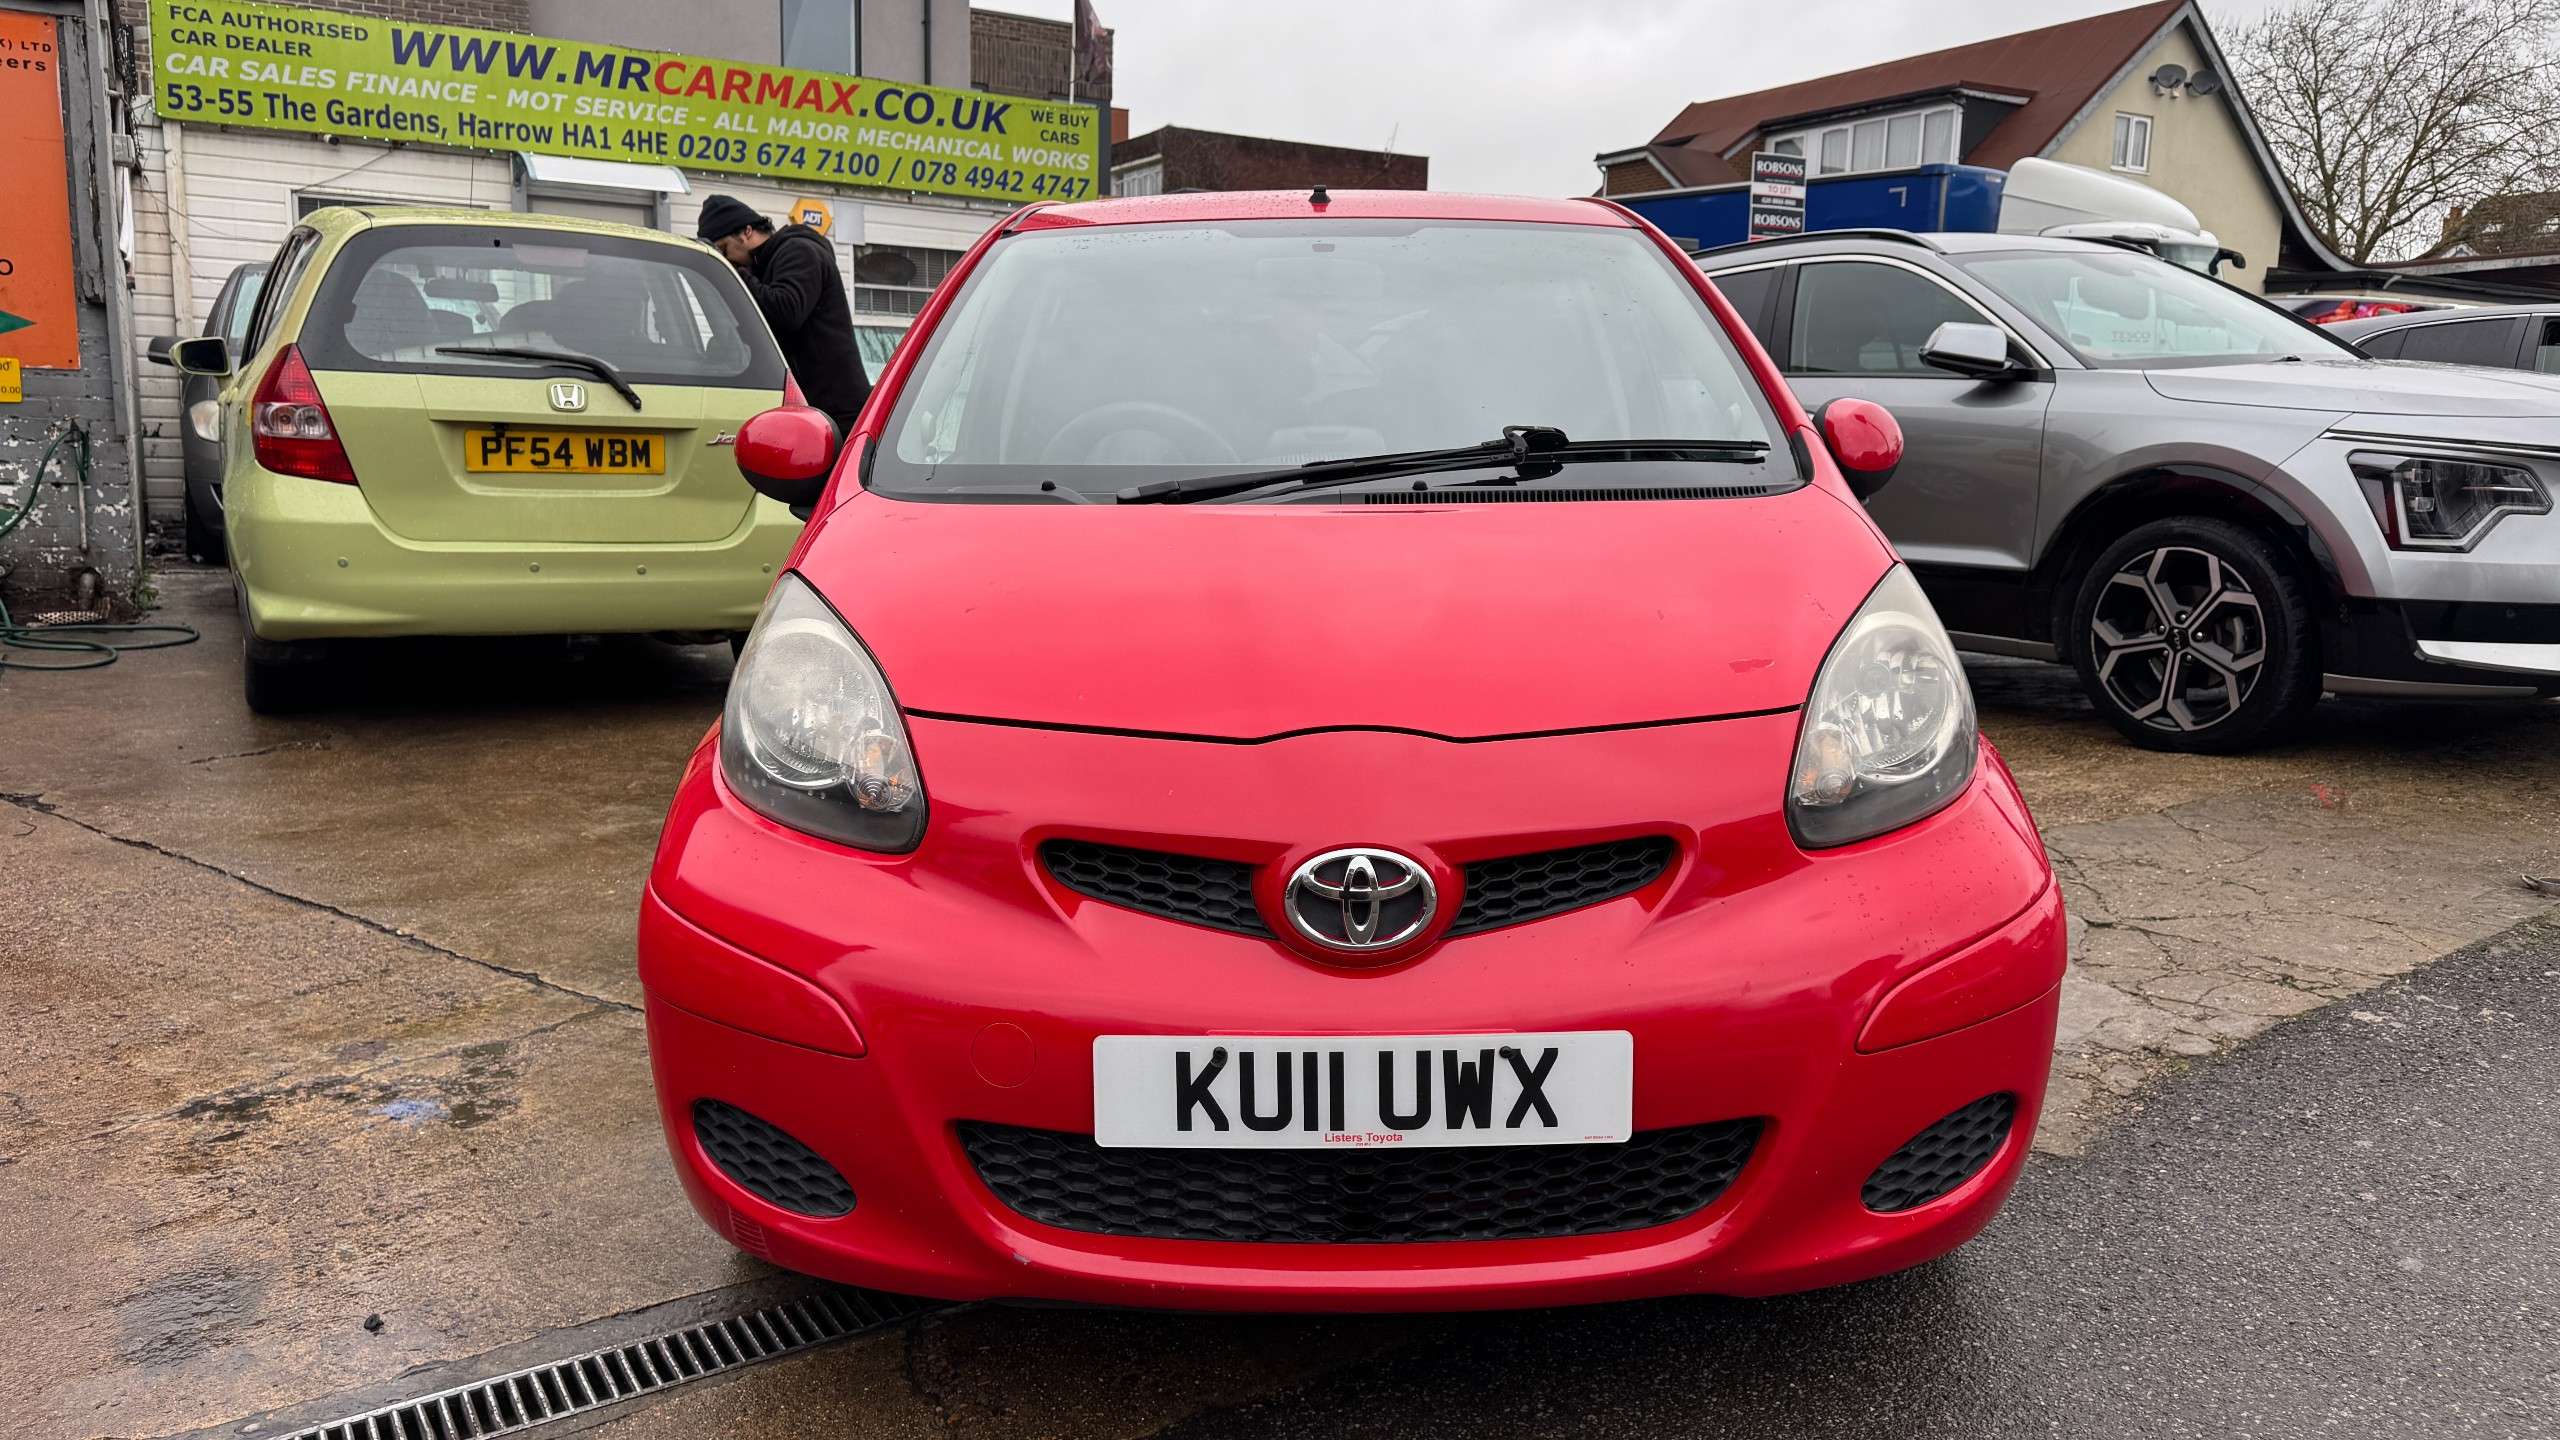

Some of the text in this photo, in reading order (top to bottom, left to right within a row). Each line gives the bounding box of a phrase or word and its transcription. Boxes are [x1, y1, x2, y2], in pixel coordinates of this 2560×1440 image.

[170, 6, 368, 41] FCA AUTHORISED
[21, 41, 51, 52] LTD
[170, 28, 312, 57] CAR DEALER
[0, 58, 46, 71] ers
[391, 28, 1012, 134] WWW.MRCARMAX.CO.UK
[165, 53, 229, 78] CAR
[240, 60, 336, 89] SALES
[346, 71, 477, 103] FINANCE
[506, 89, 568, 113] MOT
[575, 96, 689, 126] SERVICE
[714, 112, 758, 134] ALL
[767, 118, 849, 144] MAJOR
[857, 127, 1003, 161] MECHANICAL
[1012, 146, 1090, 171] WORKS
[1030, 110, 1089, 128] WE BUY
[167, 83, 1090, 199] 53-55 The Gardens, Harrow HA1 4HE 0203 674 7100 / 078 4942 4747
[1040, 130, 1080, 145] CARS
[1757, 160, 1803, 176] ROBSONS
[1768, 185, 1792, 194] TO LET
[804, 211, 821, 224] ADT
[1754, 214, 1801, 229] ROBSONS
[481, 437, 651, 468] PF54 WBM
[1176, 1048, 1559, 1131] KU11 UWX
[1325, 1133, 1402, 1143] Listers Toyota
